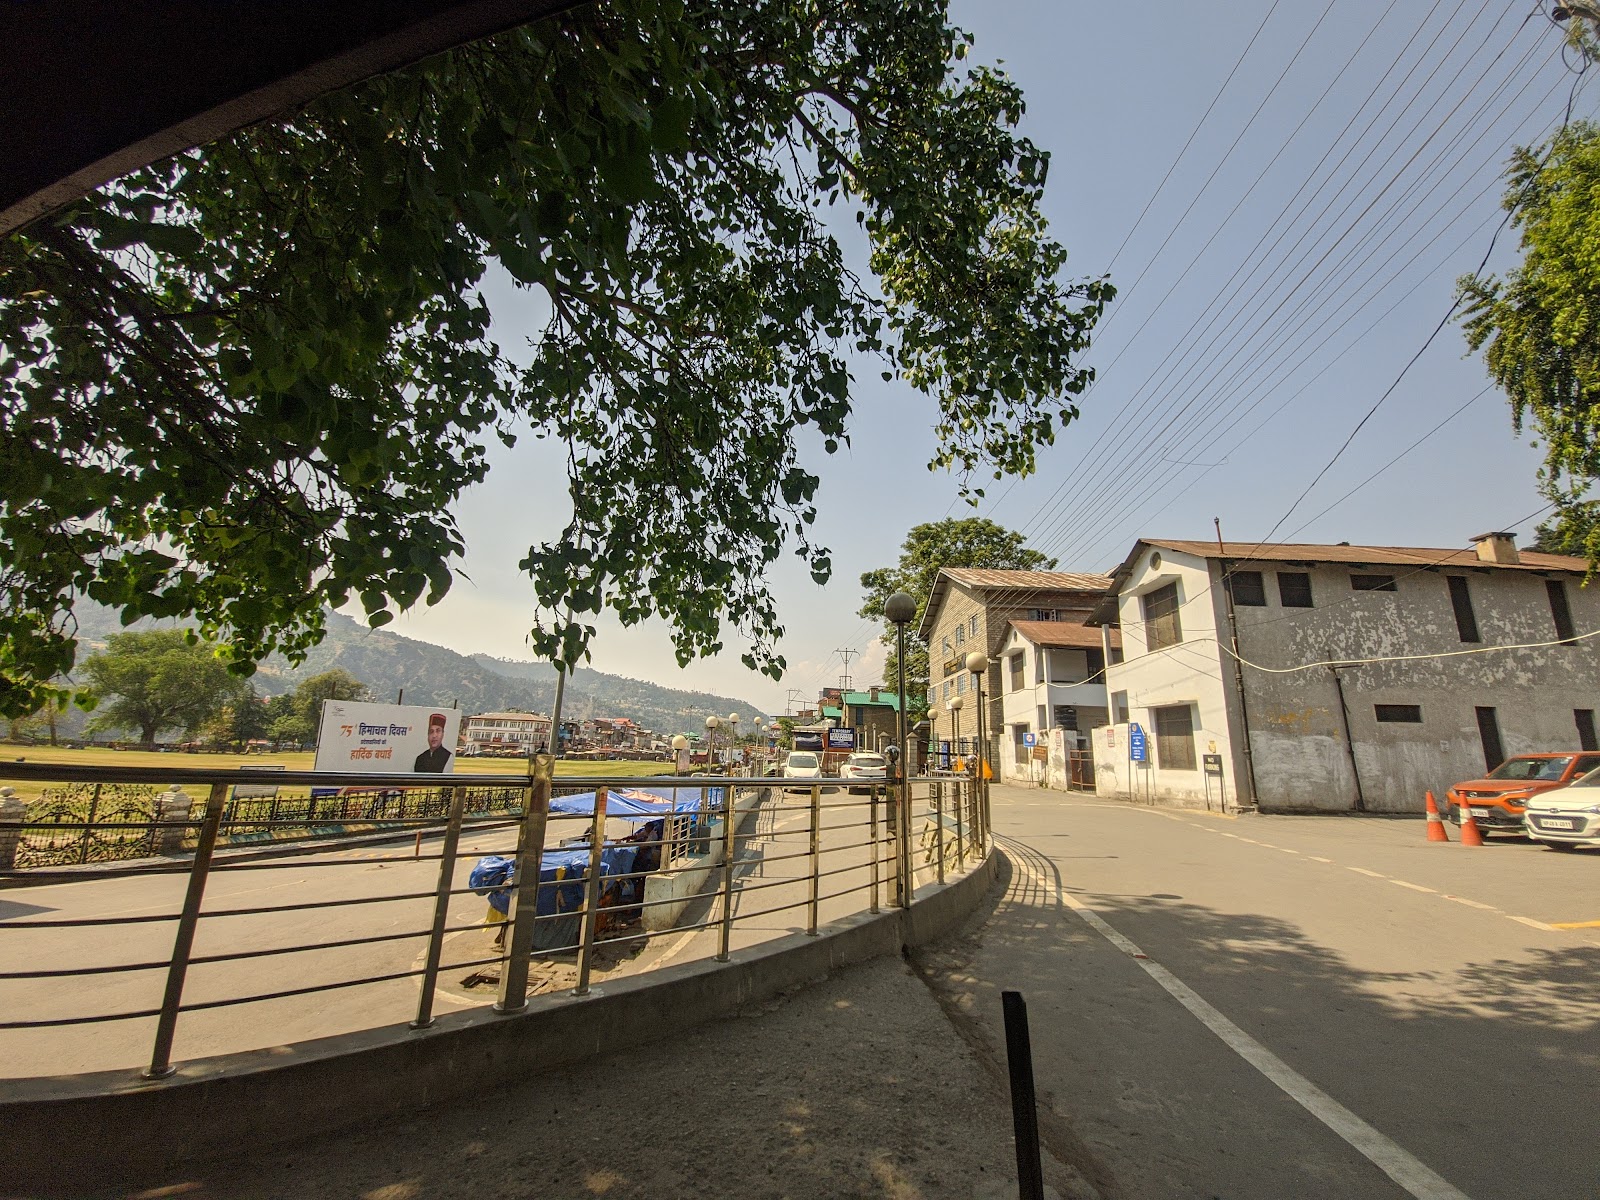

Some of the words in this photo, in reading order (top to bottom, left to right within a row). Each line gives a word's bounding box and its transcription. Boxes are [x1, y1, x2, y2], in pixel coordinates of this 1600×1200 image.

[358, 722, 388, 736] हिमाचल
[389, 723, 408, 737] दिवस
[350, 747, 373, 761] हार्दिक
[374, 746, 393, 760] बधाई
[1204, 763, 1220, 771] PARKING
